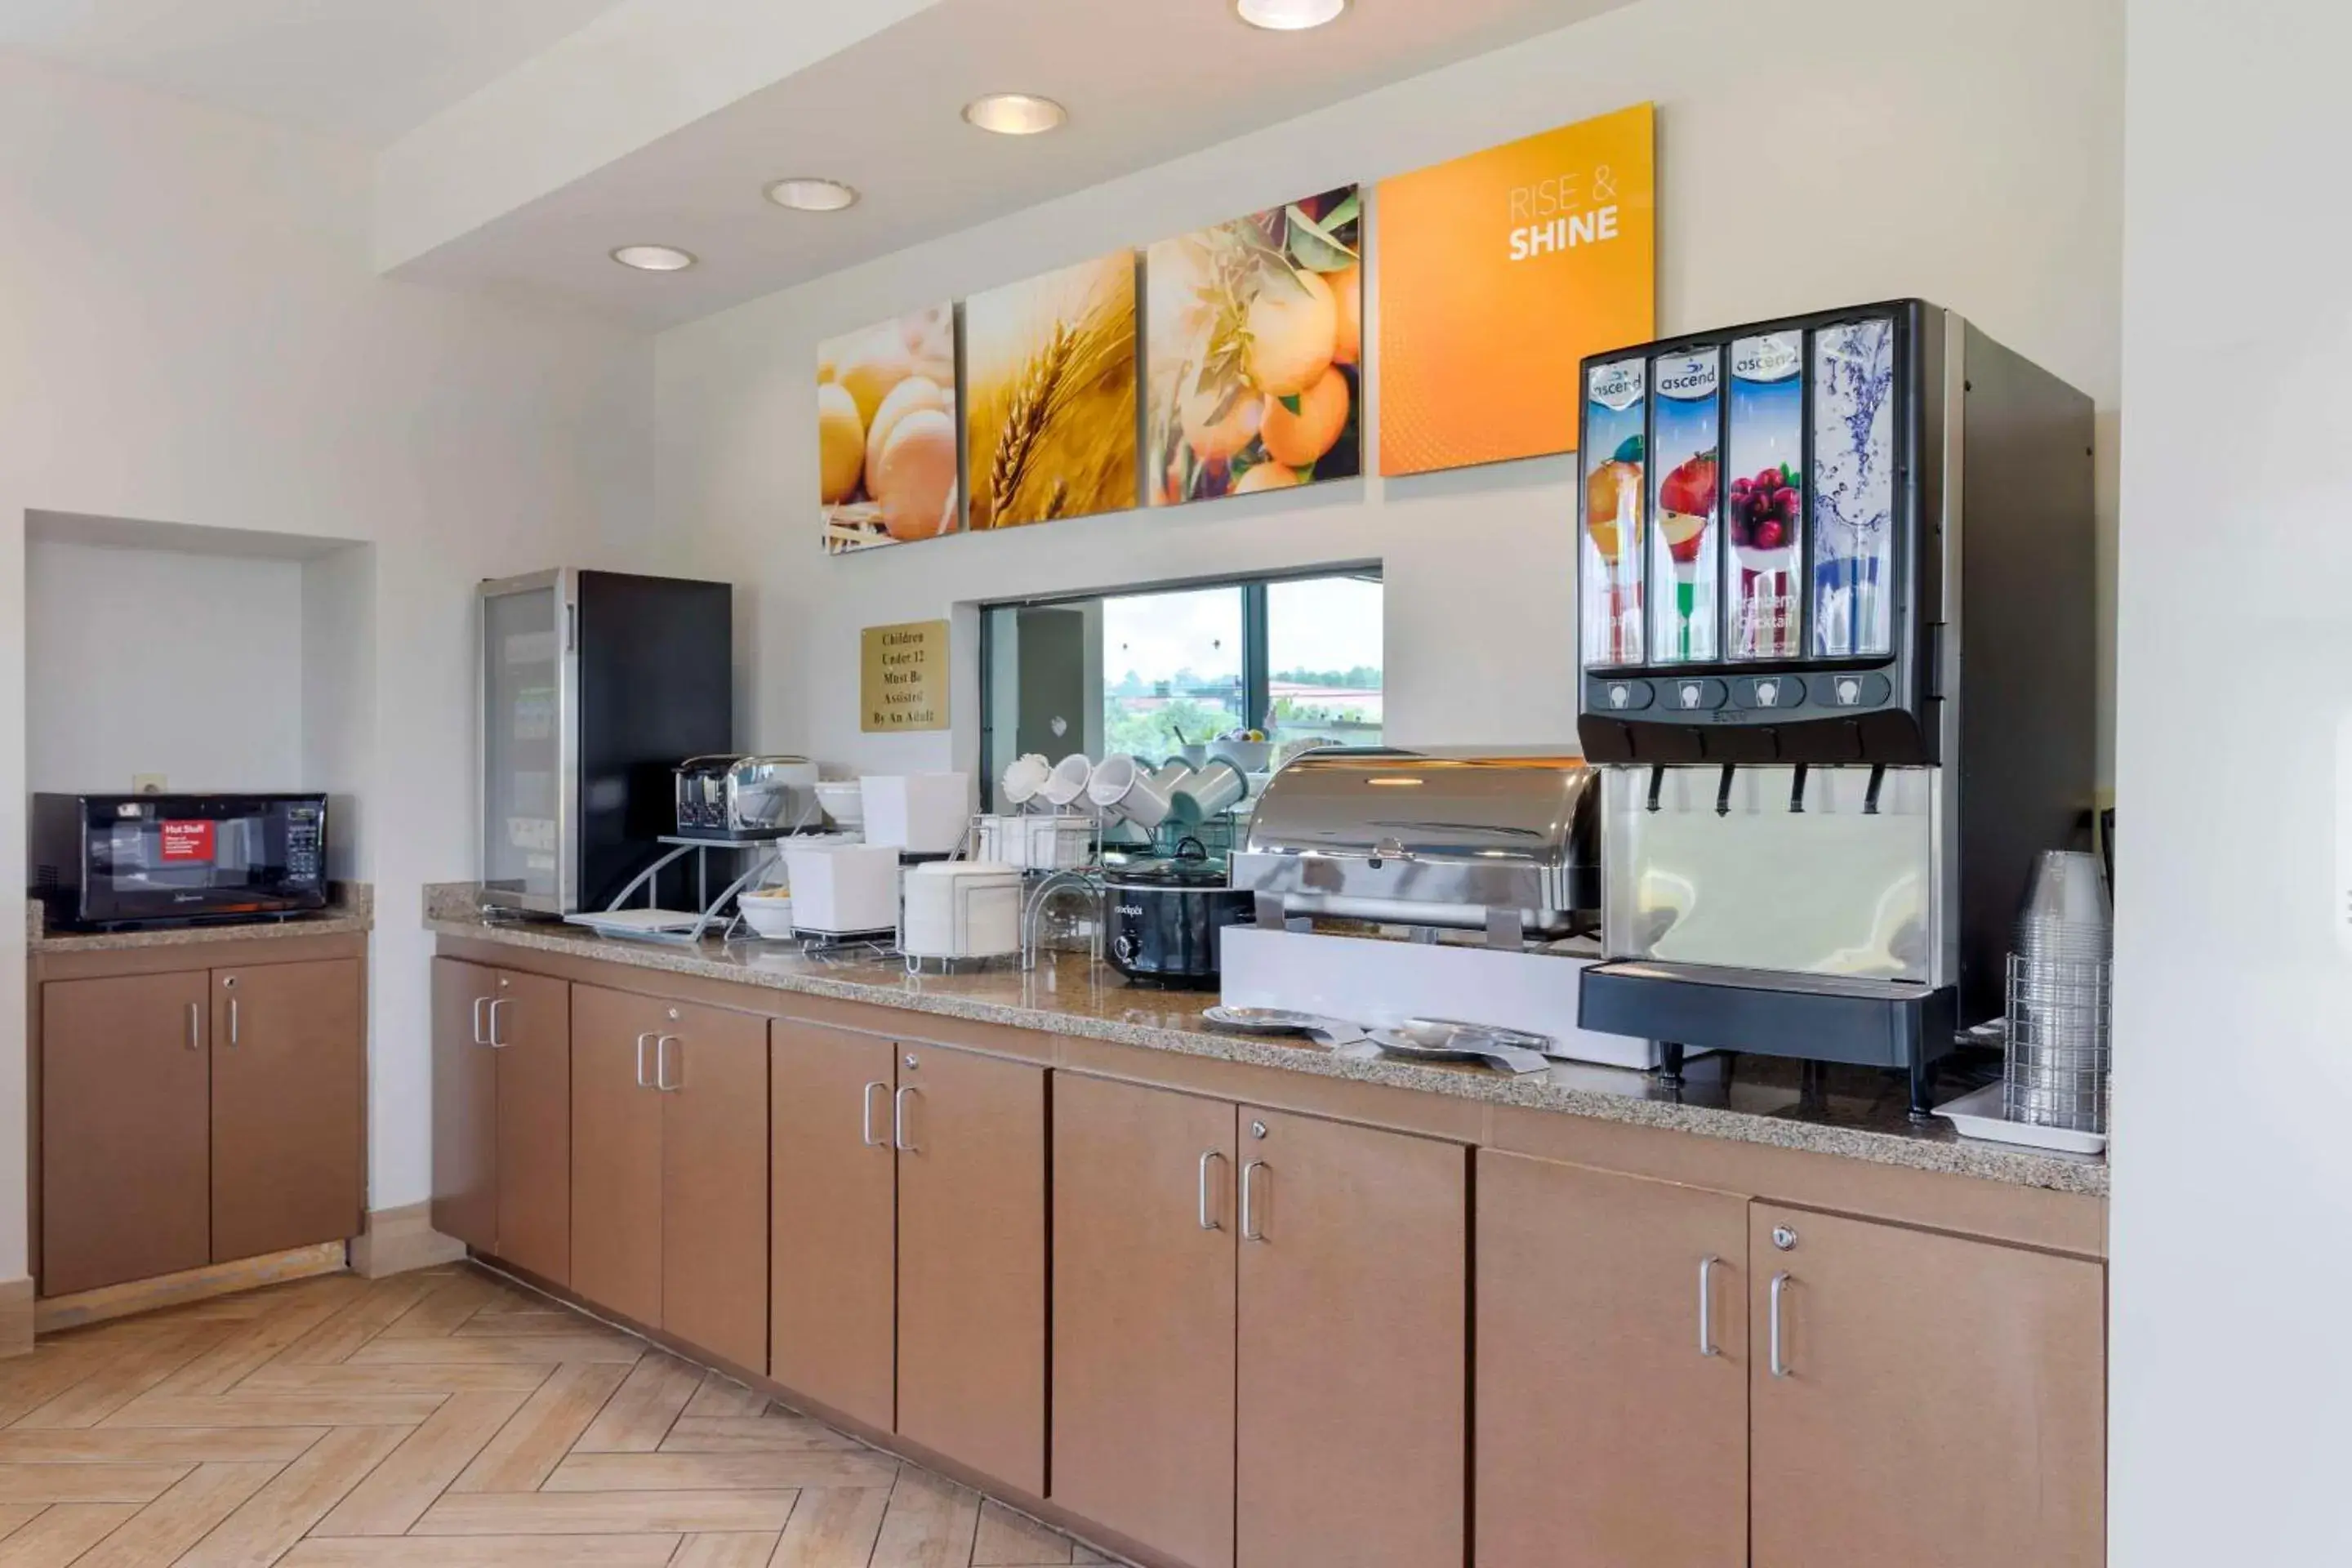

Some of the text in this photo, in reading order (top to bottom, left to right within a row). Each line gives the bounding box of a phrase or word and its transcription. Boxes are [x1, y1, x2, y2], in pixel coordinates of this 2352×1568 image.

[1510, 164, 1618, 225] RISE &
[1509, 204, 1619, 261] SHINE
[1661, 363, 1715, 390] ascend
[1735, 595, 1798, 612] ranberry
[882, 631, 924, 646] Children
[882, 653, 911, 666] Under
[884, 672, 908, 684] Must
[884, 690, 924, 705] Assisted
